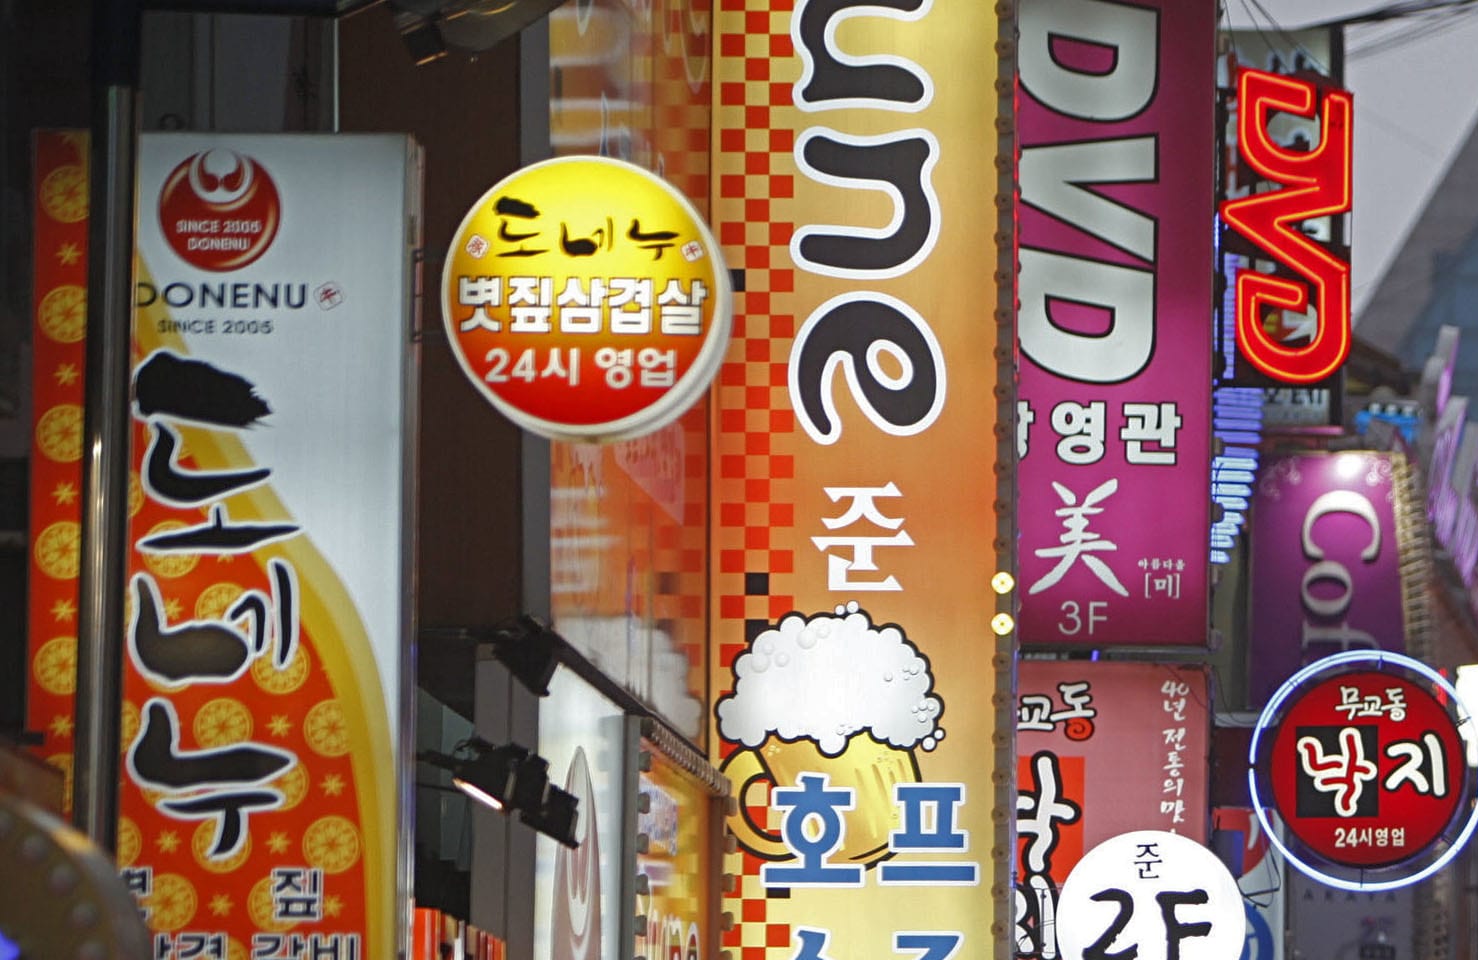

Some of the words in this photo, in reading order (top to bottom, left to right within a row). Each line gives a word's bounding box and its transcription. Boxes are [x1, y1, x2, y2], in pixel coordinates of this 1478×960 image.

[1018, 2, 1160, 386] DVD
[176, 219, 219, 233] SINCE
[187, 238, 249, 251] DONENU
[492, 195, 681, 261] 도네누
[1217, 64, 1354, 386] DVD
[135, 281, 308, 309] DONENU
[458, 275, 708, 336] 볏짚삼겹살
[157, 319, 216, 335] SINCE
[484, 347, 581, 388] 24시
[594, 346, 678, 390] 영업
[810, 481, 916, 592] 준
[1027, 477, 1130, 597] 美
[1057, 600, 1109, 636] 3F
[1334, 685, 1408, 722] 무교동
[1296, 727, 1449, 818] 낙지
[762, 772, 978, 886] 호프
[1133, 843, 1163, 881] 준
[272, 866, 325, 924] 짚
